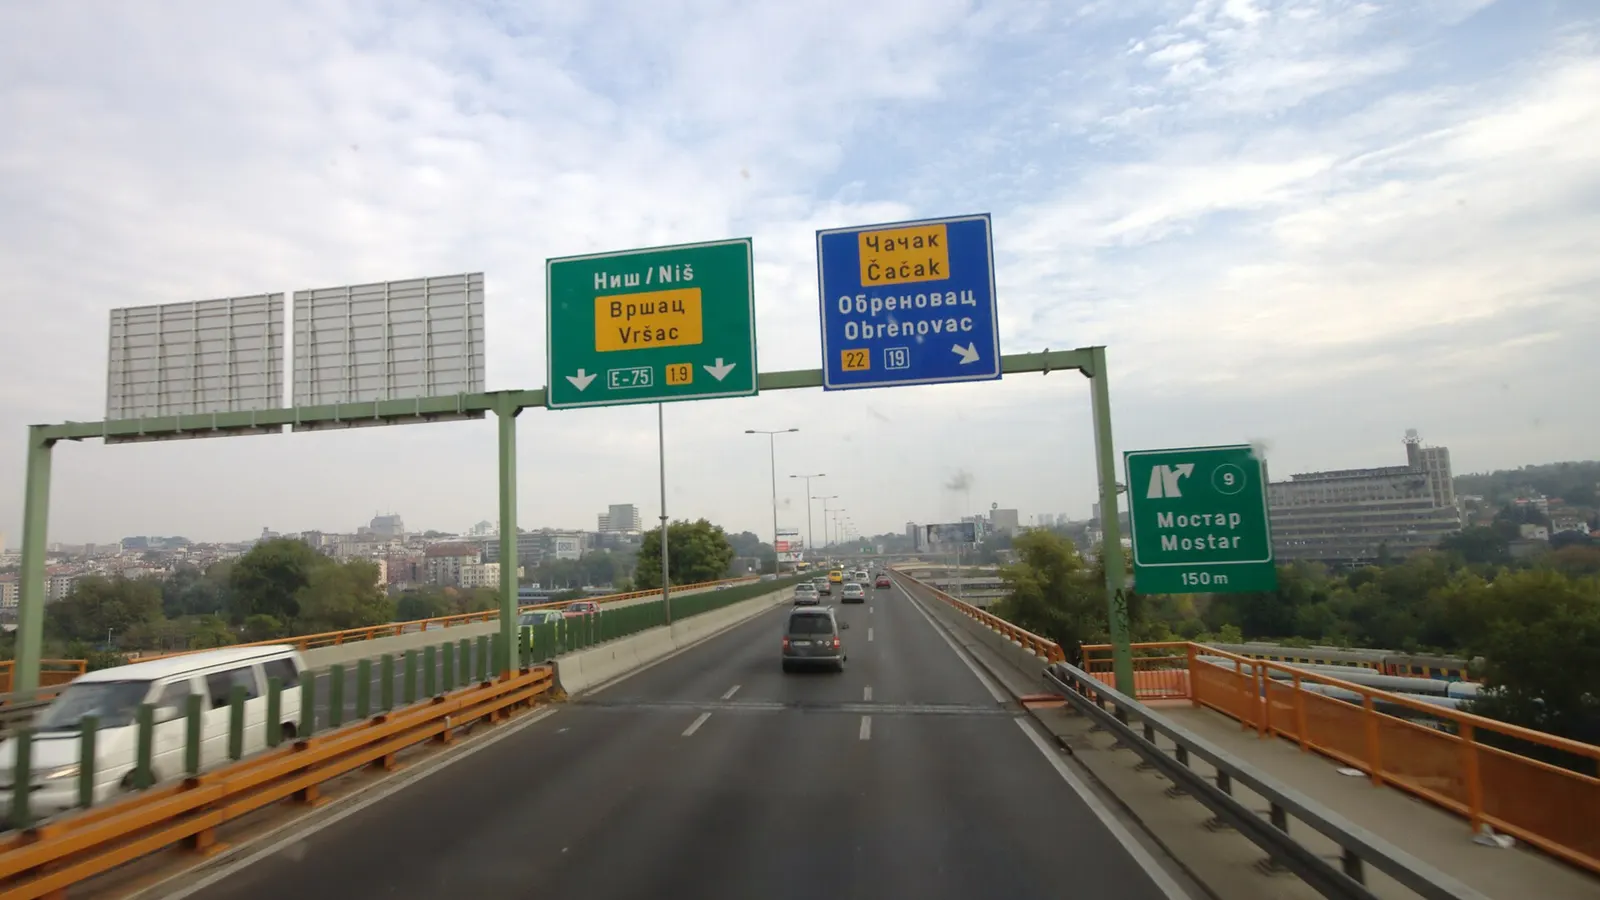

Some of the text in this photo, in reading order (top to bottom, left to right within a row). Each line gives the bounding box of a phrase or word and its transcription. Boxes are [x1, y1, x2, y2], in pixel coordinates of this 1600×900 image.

[866, 233, 940, 253] Чачак
[867, 258, 940, 281] Čačak
[610, 299, 685, 321] Вршац
[838, 290, 976, 317] Обреновац
[619, 325, 679, 344] Vršac
[844, 316, 973, 341] Obrenovac
[847, 352, 865, 368] 22
[889, 351, 905, 367] 19
[611, 369, 649, 387] E-75
[671, 366, 688, 382] 1.9
[1223, 472, 1234, 486] 9
[1157, 511, 1241, 529] Мостар
[1161, 533, 1241, 551] Mostar
[1181, 572, 1228, 585] 150 m
